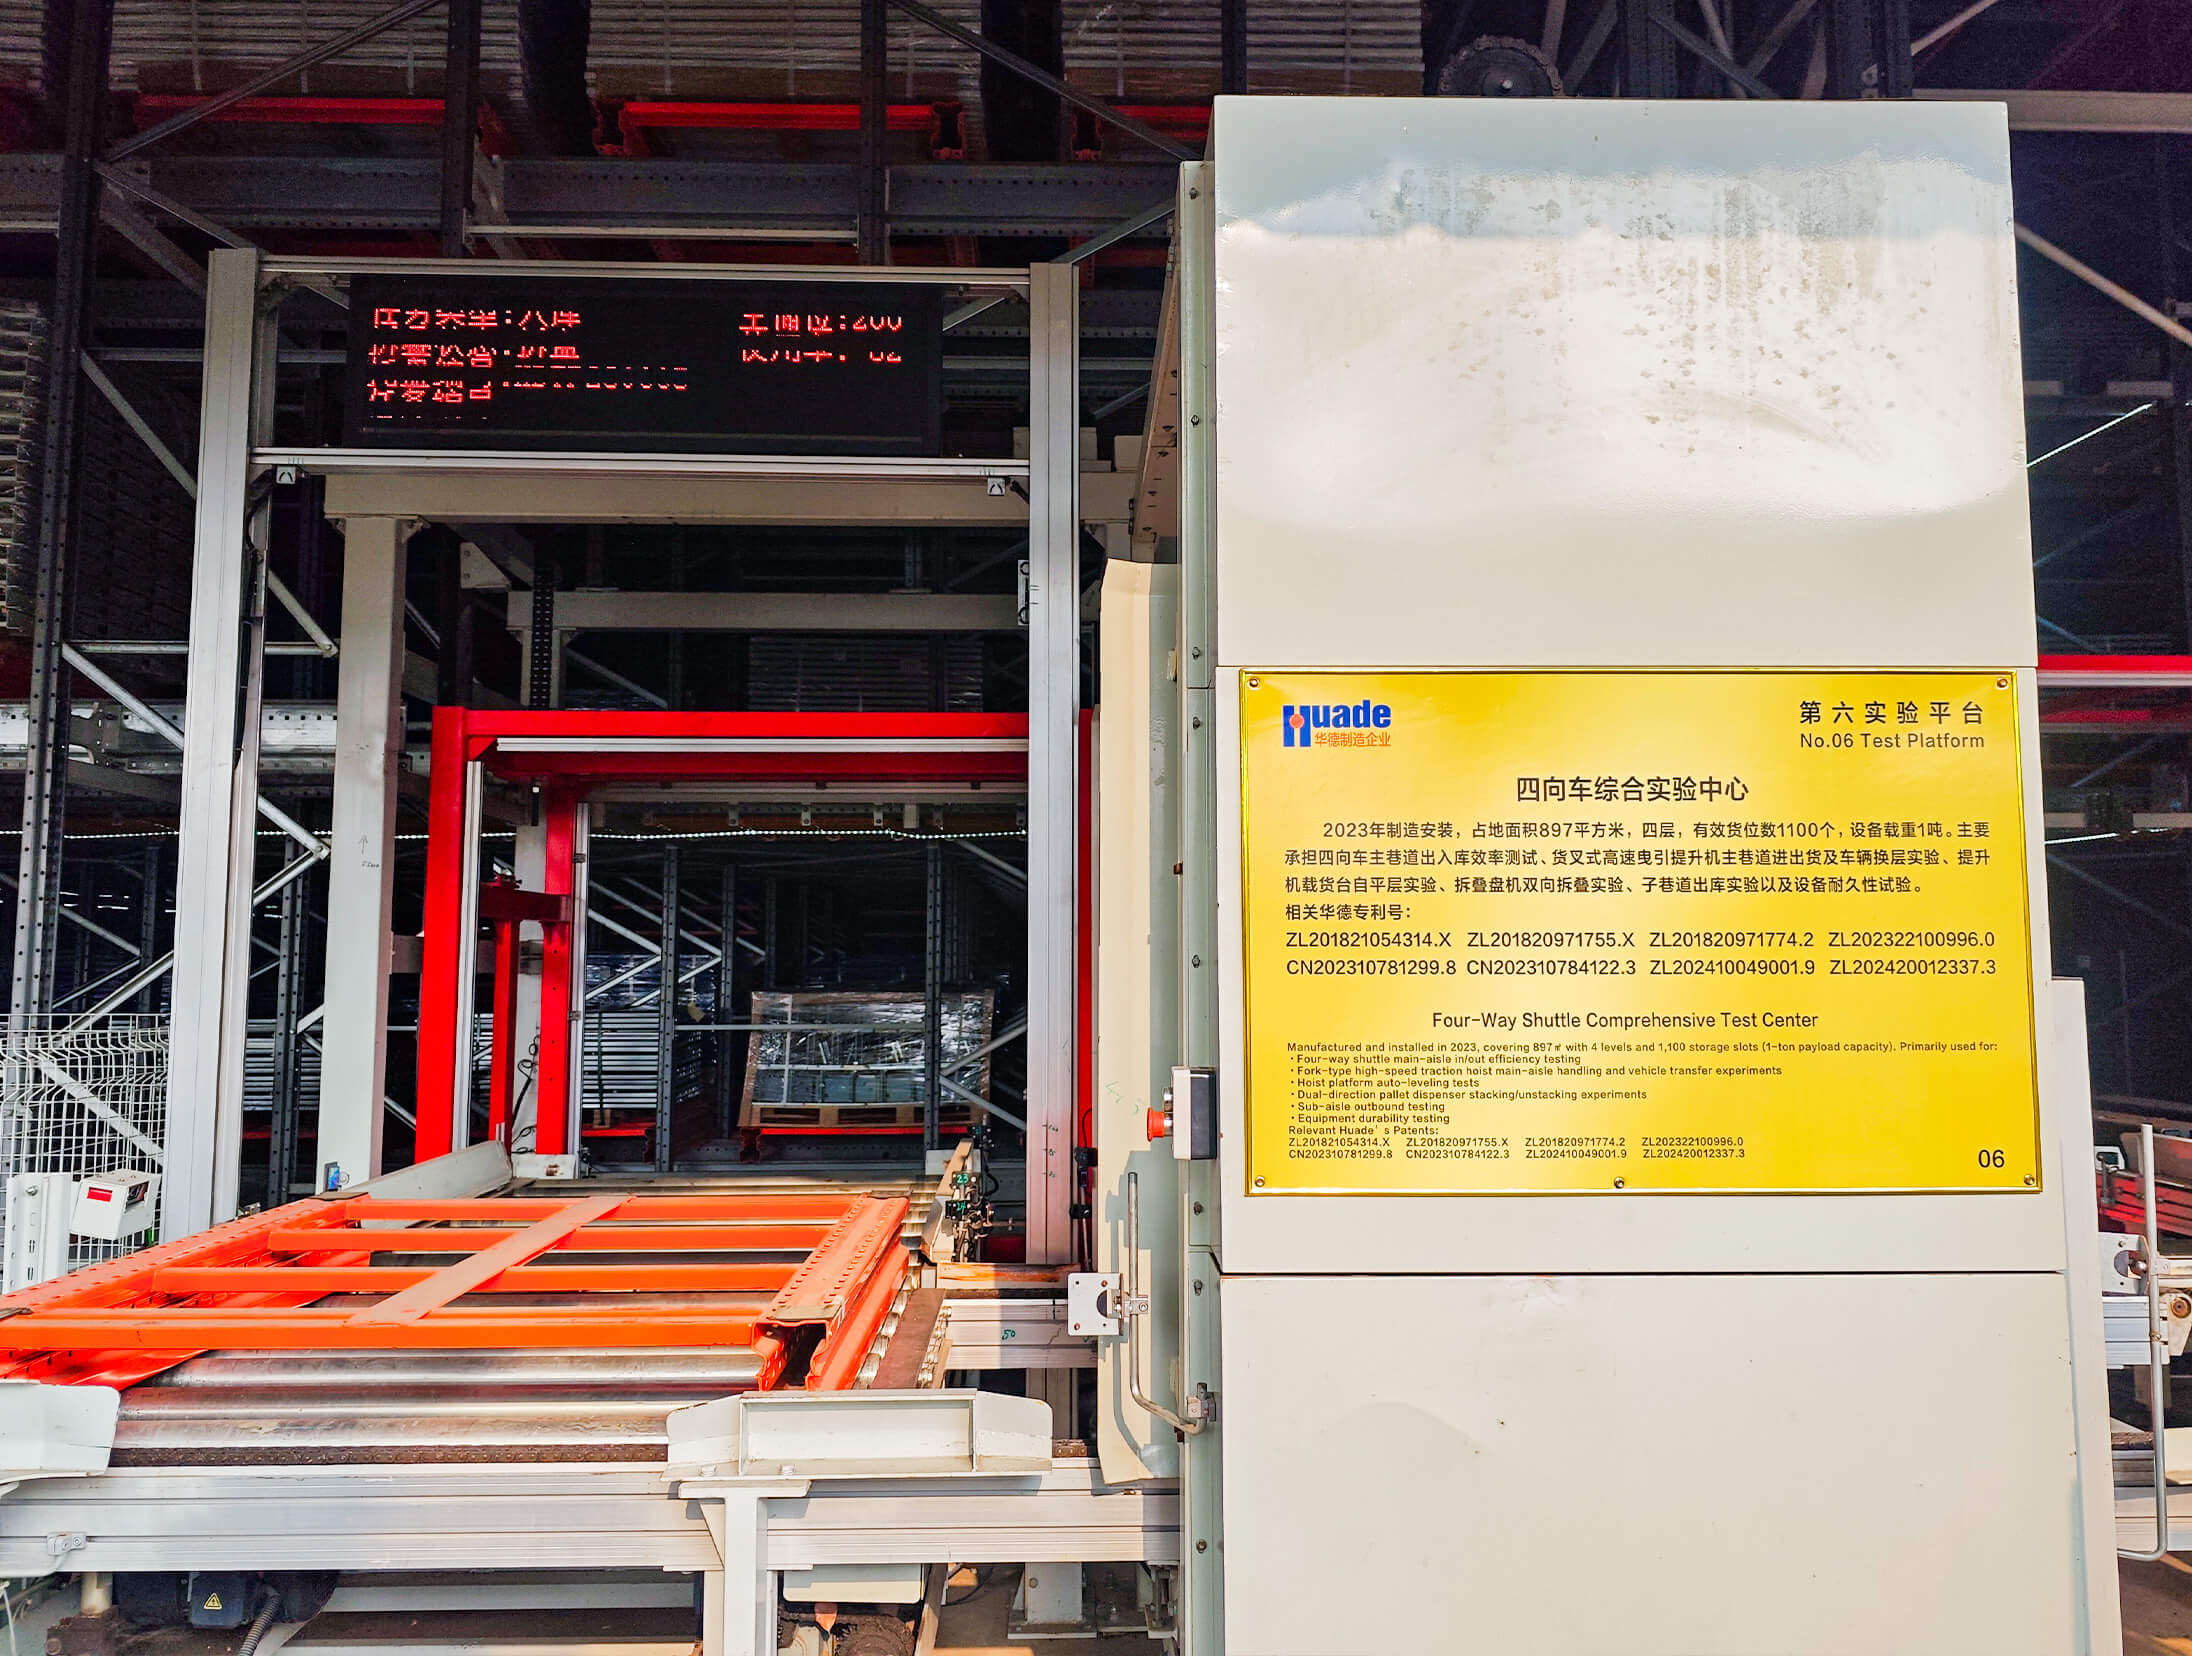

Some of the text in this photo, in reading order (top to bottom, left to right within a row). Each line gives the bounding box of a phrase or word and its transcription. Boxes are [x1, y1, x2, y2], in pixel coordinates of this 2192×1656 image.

[1800, 701, 1984, 725] 第六实验平台
[1283, 700, 1391, 747] Huade
[1314, 731, 1391, 748] 华德制造企业
[1800, 733, 1985, 748] No.06 Test Platform
[1518, 776, 1750, 802] 四向车综合实验中心
[1286, 932, 1995, 948] ZL201821054314.X ZL201820971755.X ZL201820971774.2 ZL202322100996.0
[1286, 960, 1996, 975] CN202310781299.8 CN202310784122.3 ZL202410049001.9 ZL202420012337.3
[1433, 1012, 1818, 1031] Four-Way Shuttle Comprehensive Test Center
[1287, 1043, 1362, 1052] Manufactured
[1365, 1043, 1385, 1052] and
[1388, 1042, 1434, 1052] installed
[1438, 1043, 1447, 1052] in
[1450, 1042, 1480, 1053] 2023,
[1483, 1043, 1530, 1054] covering
[1566, 1042, 1588, 1052] with
[1591, 1043, 1598, 1052] 4
[1601, 1042, 1633, 1052] levels
[1635, 1042, 1655, 1052] and
[1658, 1042, 1686, 1053] 1,100
[1689, 1043, 1730, 1053] storage
[1733, 1042, 1759, 1052] slots
[1762, 1041, 1796, 1052] (1-ton
[1798, 1042, 1841, 1053] payload
[1843, 1041, 1897, 1053] capacity).
[1900, 1042, 1948, 1053] Primarily
[1950, 1042, 1976, 1051] used
[1979, 1041, 1998, 1051] for:
[1297, 1055, 1581, 1066] Four-way shuttle main-aisle in/out efficiency testing
[1297, 1066, 1783, 1077] Fork-type high-speed traction hoist main-aisle handling and vehicle transfer experiments
[1297, 1078, 1480, 1089] Hoist platform auto-leveling tests
[1297, 1090, 1648, 1101] Dual-direction pallet dispenser stacking/unstacking experiments
[1297, 1102, 1445, 1113] Sub-aisle outbound testing
[1297, 1114, 1450, 1125] Equipment durability testing
[1288, 1125, 1336, 1135] Relevant
[1393, 1125, 1439, 1135] Patents:
[1288, 1137, 1744, 1148] ZL201821054314.X ZL201820971755.X ZL201820971774.2 ZL202322100996.0
[1288, 1148, 1746, 1159] CN202310781299.8 CN202310784122.3 ZL202410049001.9 ZL202420012337.3
[1978, 1149, 2005, 1168] 06
